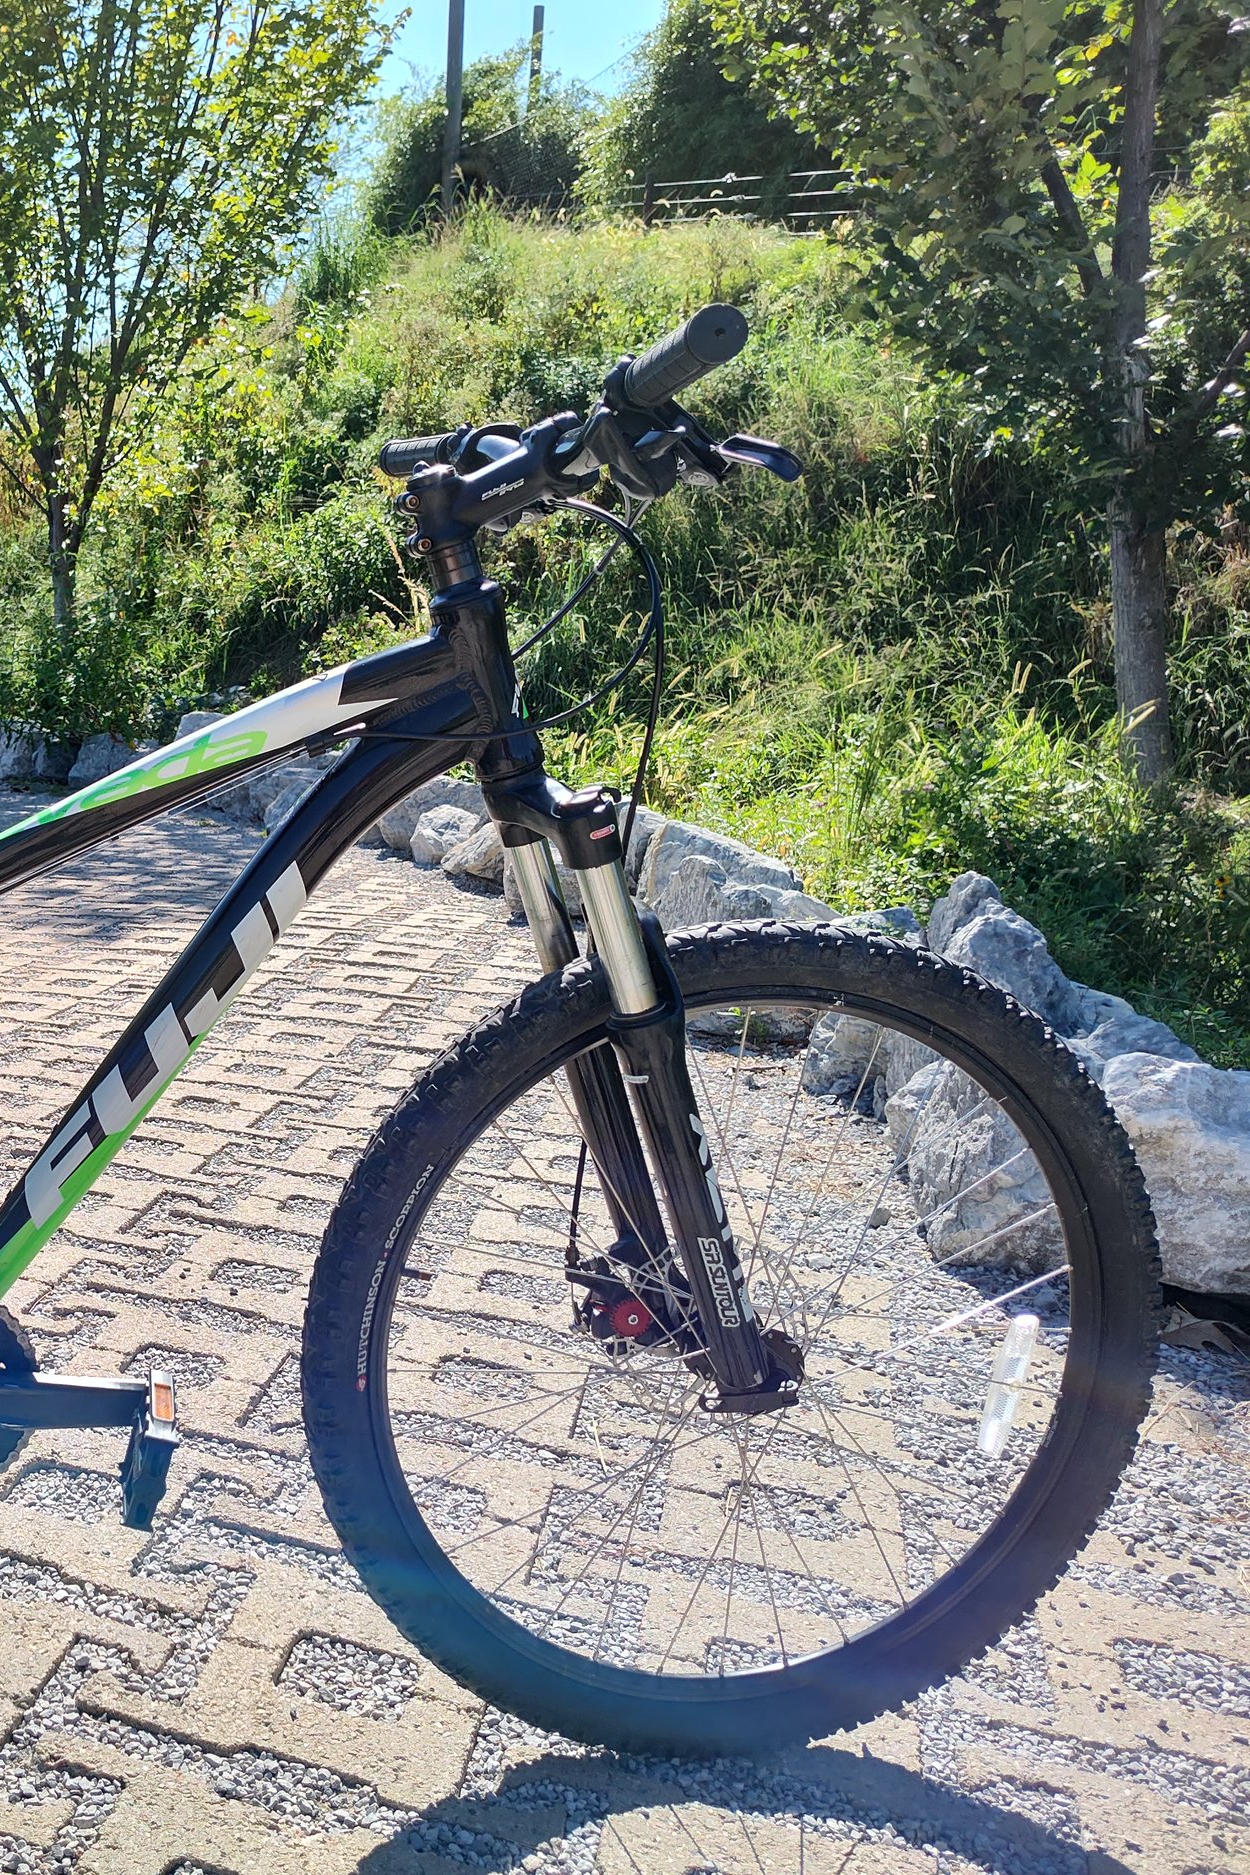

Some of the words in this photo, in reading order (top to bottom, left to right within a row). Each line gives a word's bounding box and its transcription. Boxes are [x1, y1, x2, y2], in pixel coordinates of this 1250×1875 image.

[24, 861, 307, 1230] FUJI
[357, 1260, 387, 1376] HUTCHINSON
[385, 1164, 435, 1249] SCORPION
[698, 1237, 723, 1264] SR
[708, 1264, 740, 1327] SUNTOUR
